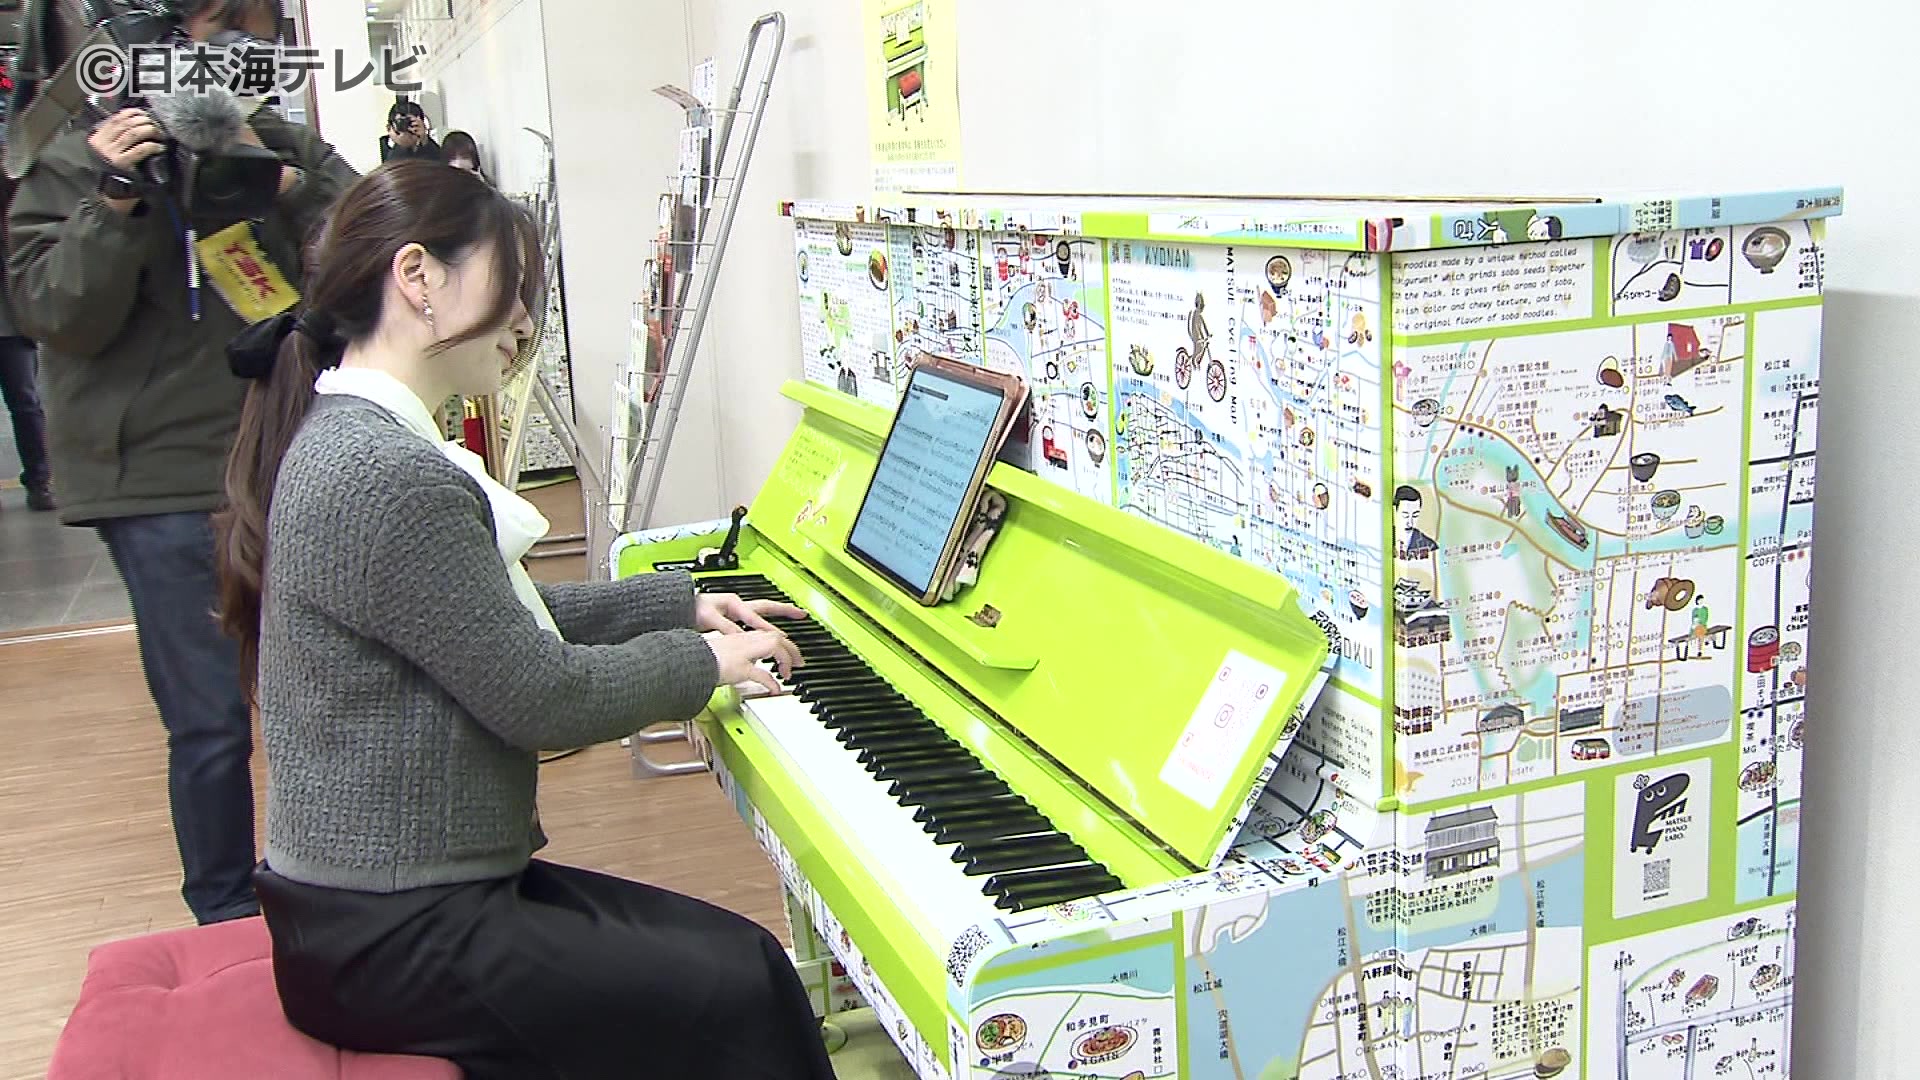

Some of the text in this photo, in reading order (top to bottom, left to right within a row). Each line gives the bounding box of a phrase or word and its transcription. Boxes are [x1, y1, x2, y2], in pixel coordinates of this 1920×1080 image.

[1404, 258, 1437, 269] noodles
[1441, 257, 1460, 266] made
[1464, 256, 1475, 266] by
[1487, 254, 1515, 265] unique
[1519, 250, 1546, 260] method
[1550, 248, 1577, 258] called
[1442, 272, 1465, 282] which
[1469, 270, 1497, 282] grinds
[1501, 268, 1520, 277] soba
[1523, 265, 1546, 275] seeds
[1550, 262, 1586, 275] together
[1404, 291, 1418, 300] the
[1464, 285, 1487, 297] gives
[1492, 282, 1510, 292] rich
[1514, 281, 1537, 291] aroma
[1540, 278, 1551, 288] of
[1423, 304, 1446, 314] color
[1451, 302, 1465, 311] and
[1469, 300, 1492, 311] chewy
[1536, 294, 1550, 303] and
[1554, 293, 1572, 301] this
[1414, 317, 1451, 331] original
[1455, 315, 1484, 325] flavor
[1487, 312, 1498, 322] of
[1501, 311, 1519, 321] soba
[1664, 825, 1688, 834] PIANO
[1193, 979, 1222, 993] 松江城
[1066, 1014, 1110, 1032] 和多見町
